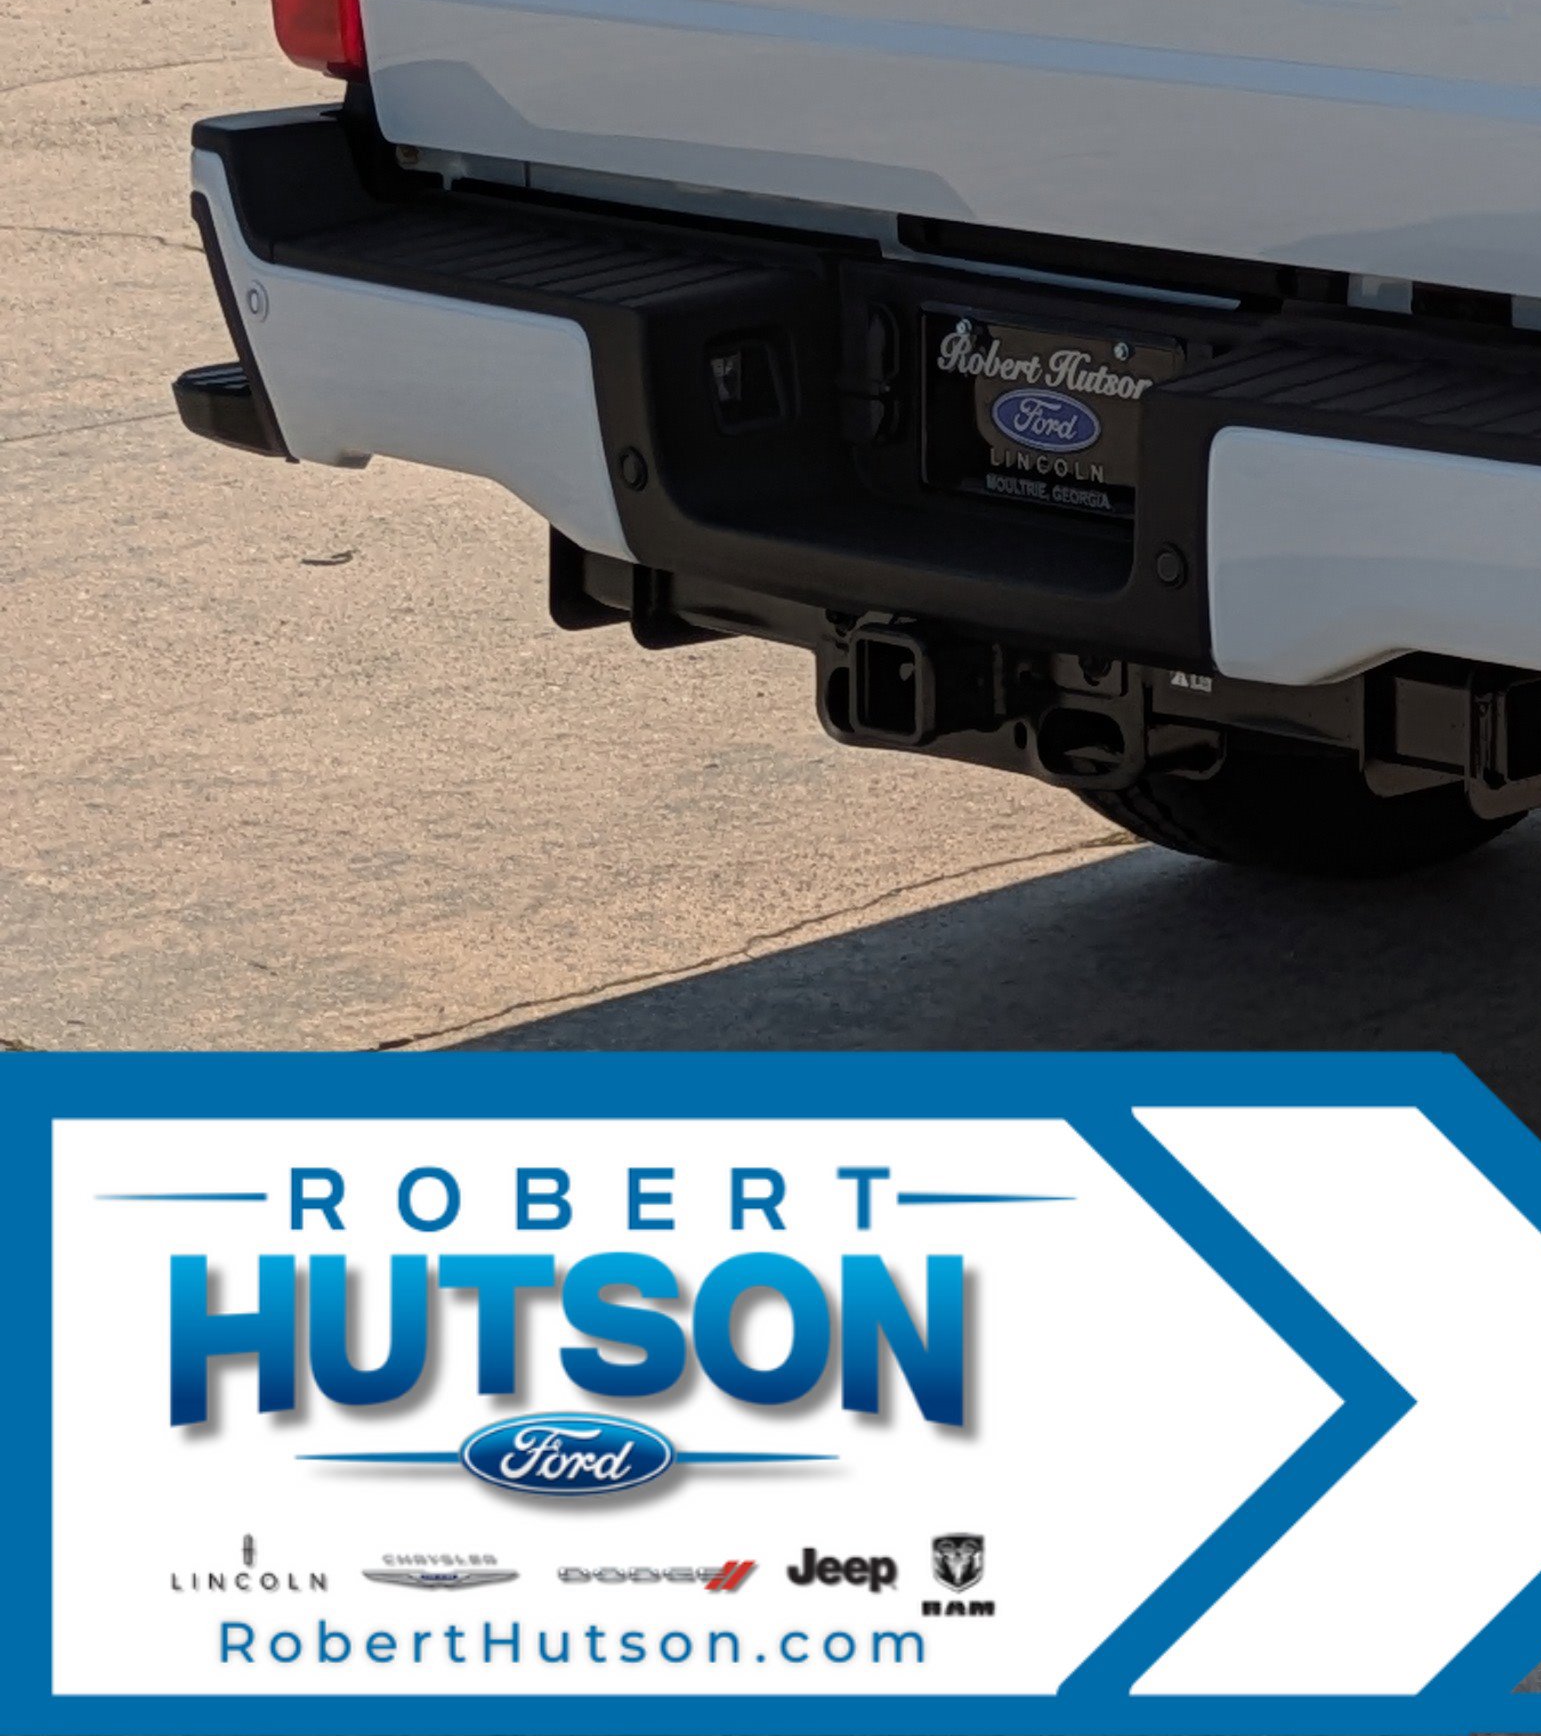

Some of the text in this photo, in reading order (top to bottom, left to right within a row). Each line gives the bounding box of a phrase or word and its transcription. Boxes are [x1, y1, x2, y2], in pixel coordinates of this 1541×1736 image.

[937, 332, 1043, 385] Robert
[1012, 397, 1078, 441] Ford
[990, 448, 1105, 484] LINCOLN
[1052, 484, 1112, 510] GEORGIA
